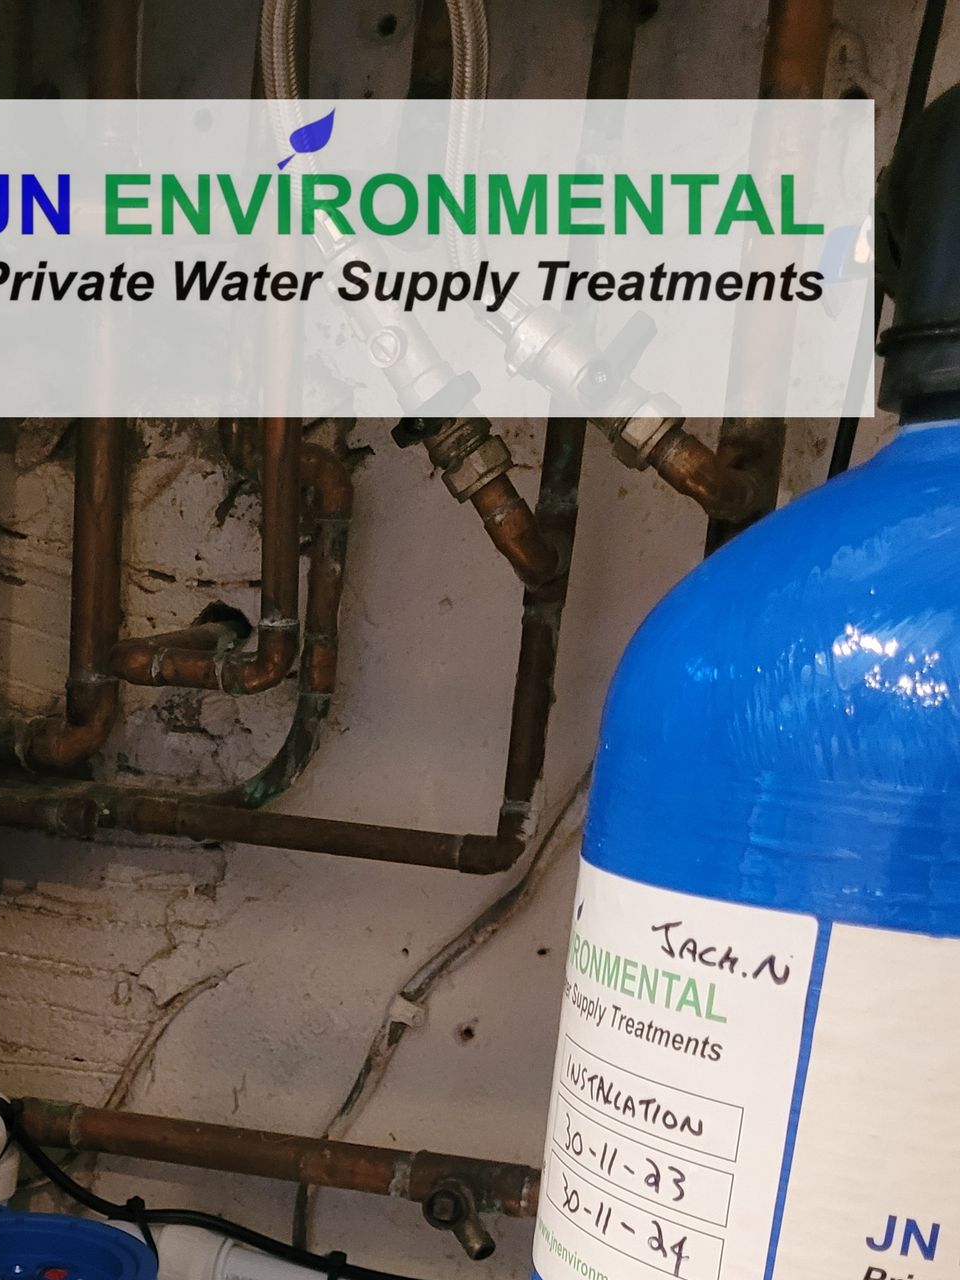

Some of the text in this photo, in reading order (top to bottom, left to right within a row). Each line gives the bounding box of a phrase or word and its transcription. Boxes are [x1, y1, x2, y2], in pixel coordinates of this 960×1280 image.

[572, 982, 607, 1028] Supply
[611, 1004, 724, 1062] Treatments
[566, 1054, 703, 1137] INSTALLATION
[866, 1214, 941, 1262] JN
